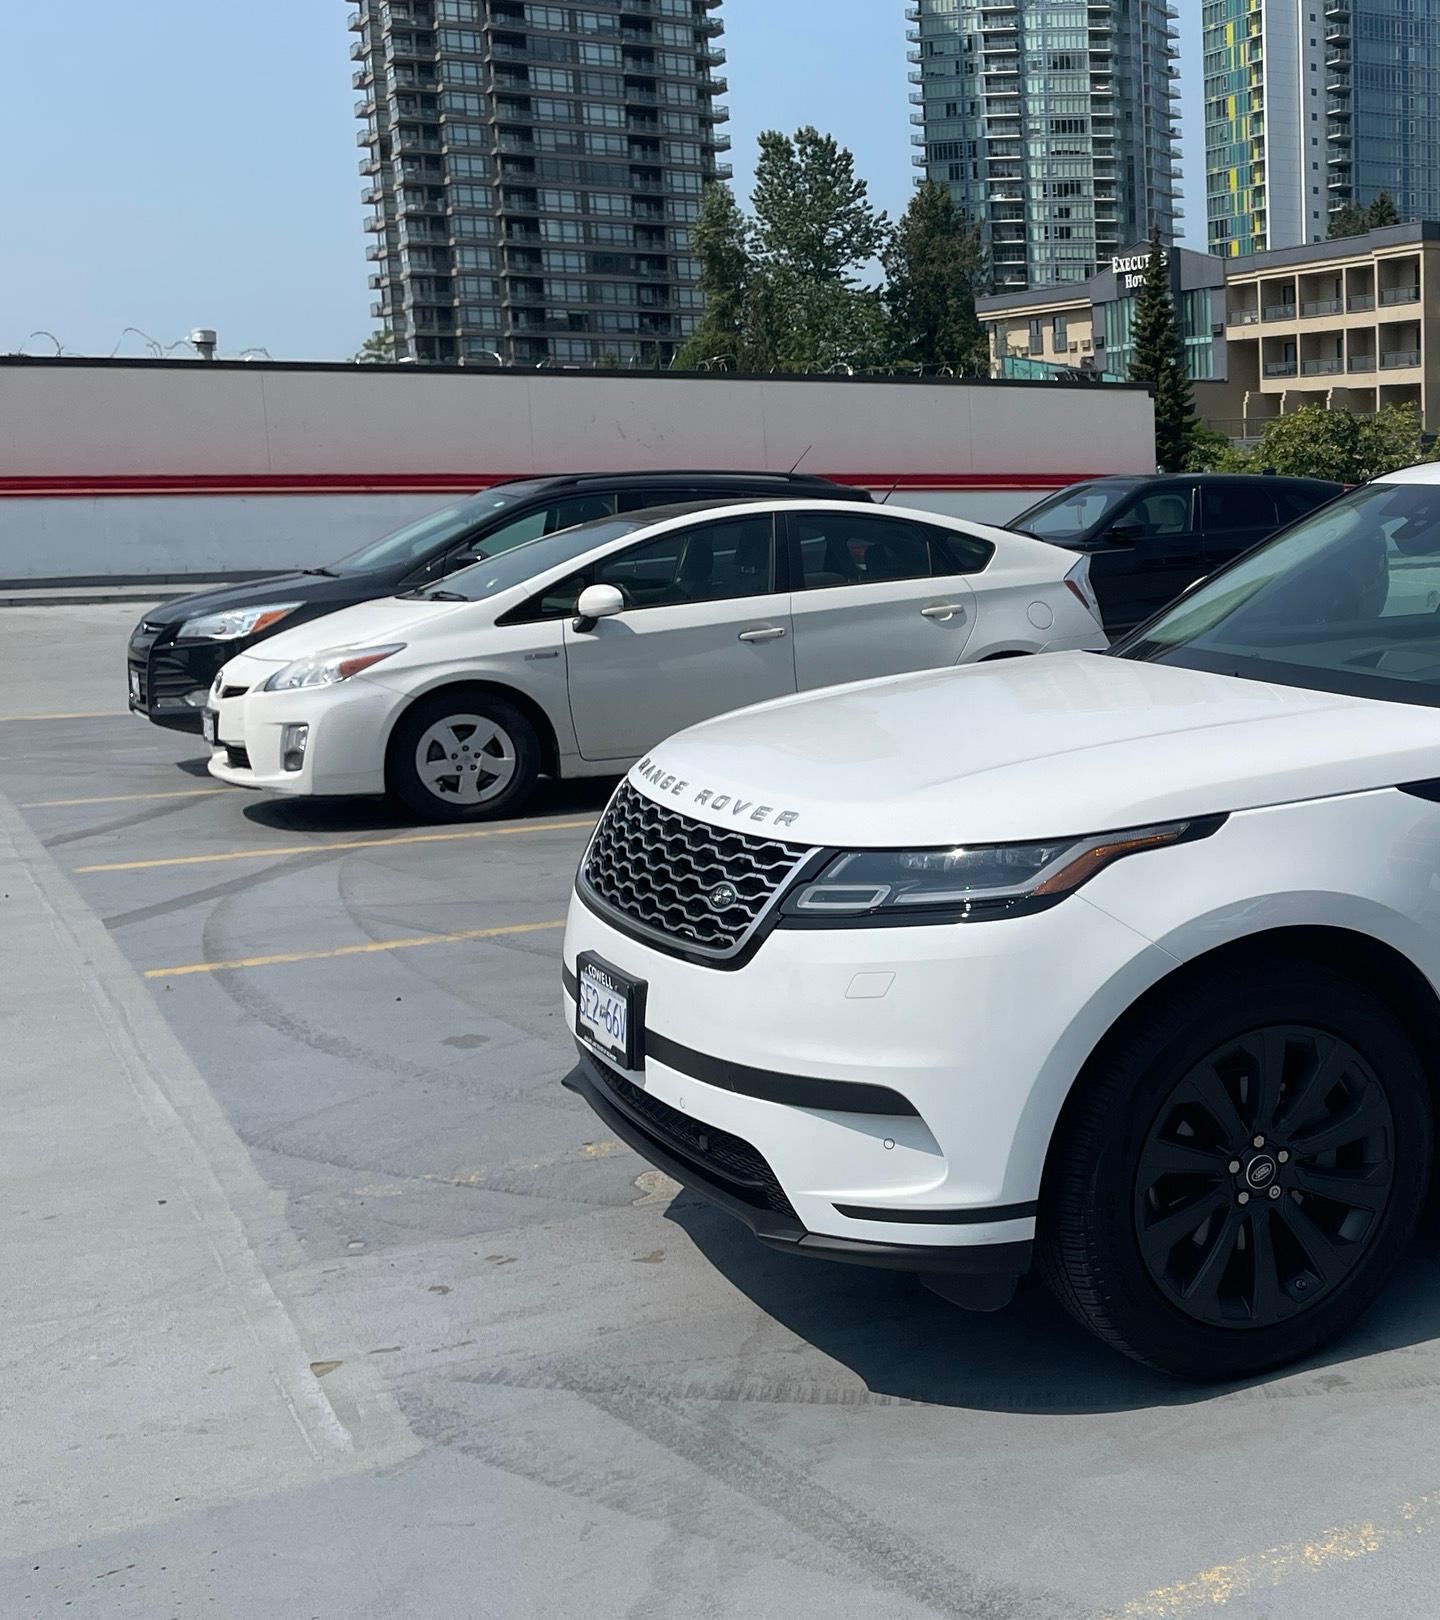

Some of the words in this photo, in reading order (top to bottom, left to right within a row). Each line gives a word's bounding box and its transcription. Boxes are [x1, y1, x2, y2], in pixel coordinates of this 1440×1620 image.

[1112, 251, 1167, 273] EXECUT
[638, 757, 689, 796] RANGE
[693, 788, 800, 827] ROVER
[587, 963, 615, 991] COWELL
